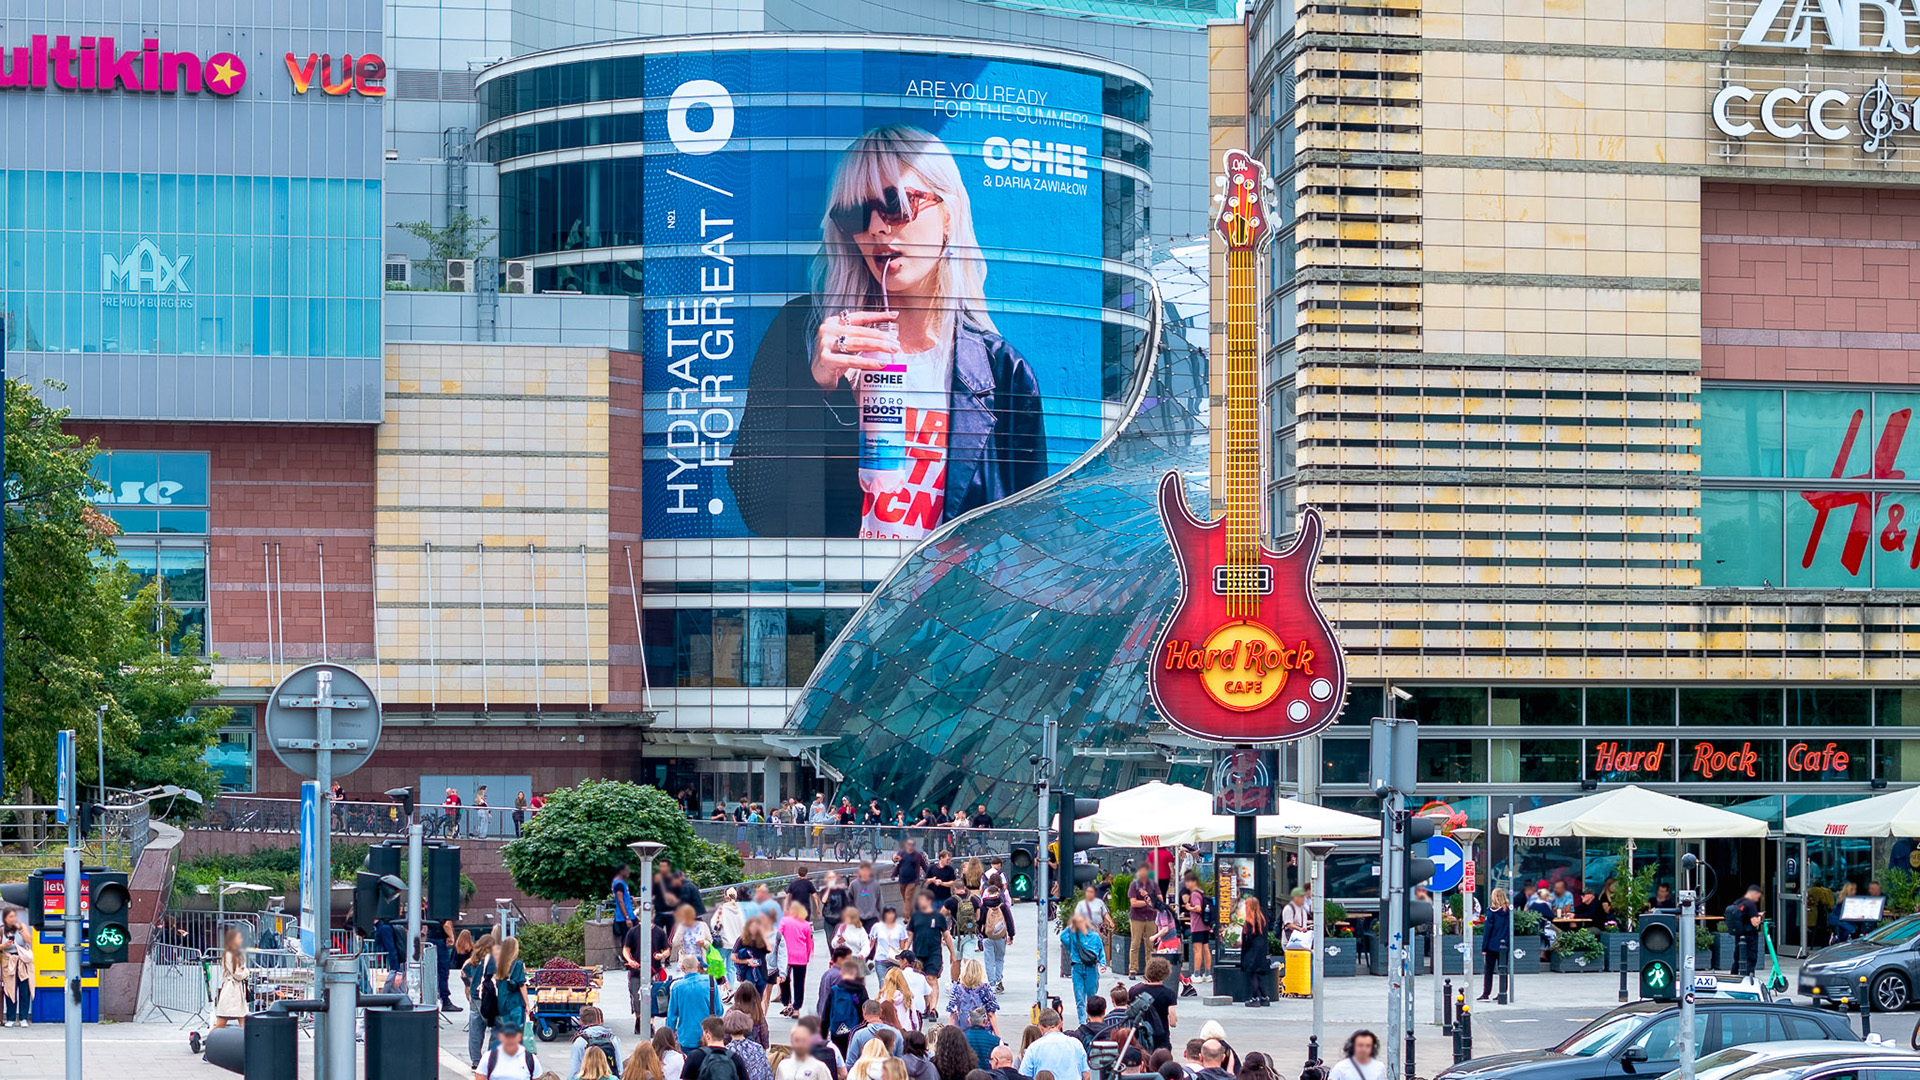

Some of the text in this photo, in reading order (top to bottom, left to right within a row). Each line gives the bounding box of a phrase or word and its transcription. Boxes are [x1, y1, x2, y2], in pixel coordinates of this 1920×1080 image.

[1738, 0, 1920, 55] ZAR
[284, 52, 387, 97] vue
[905, 80, 1048, 106] ARE YOU READY
[933, 100, 1088, 131] FOR THE SUMMER?
[1712, 85, 1850, 141] CCC
[982, 136, 1088, 180] OSHEE
[995, 175, 1032, 190] DARIA
[1033, 178, 1087, 196] ZAWIAŁOW
[102, 236, 193, 293] MAX
[101, 297, 193, 308] PREMIUM BURGERS
[701, 209, 734, 360] GREAT
[864, 373, 903, 384] OSHEE
[667, 300, 699, 513] HYDRATE
[863, 396, 903, 405] HYDRO
[863, 405, 903, 415] BOOST
[701, 375, 734, 466] FOR
[1800, 408, 1920, 577] H&
[1165, 639, 1315, 677] Hard Rock
[1224, 680, 1263, 694] CAFE
[1595, 742, 1849, 778] Hard Rock Cafe
[1513, 838, 1561, 847] AND BAR
[44, 881, 65, 893] ilety
[1220, 876, 1231, 924] BREAKFAST
[1695, 977, 1714, 986] AXI
